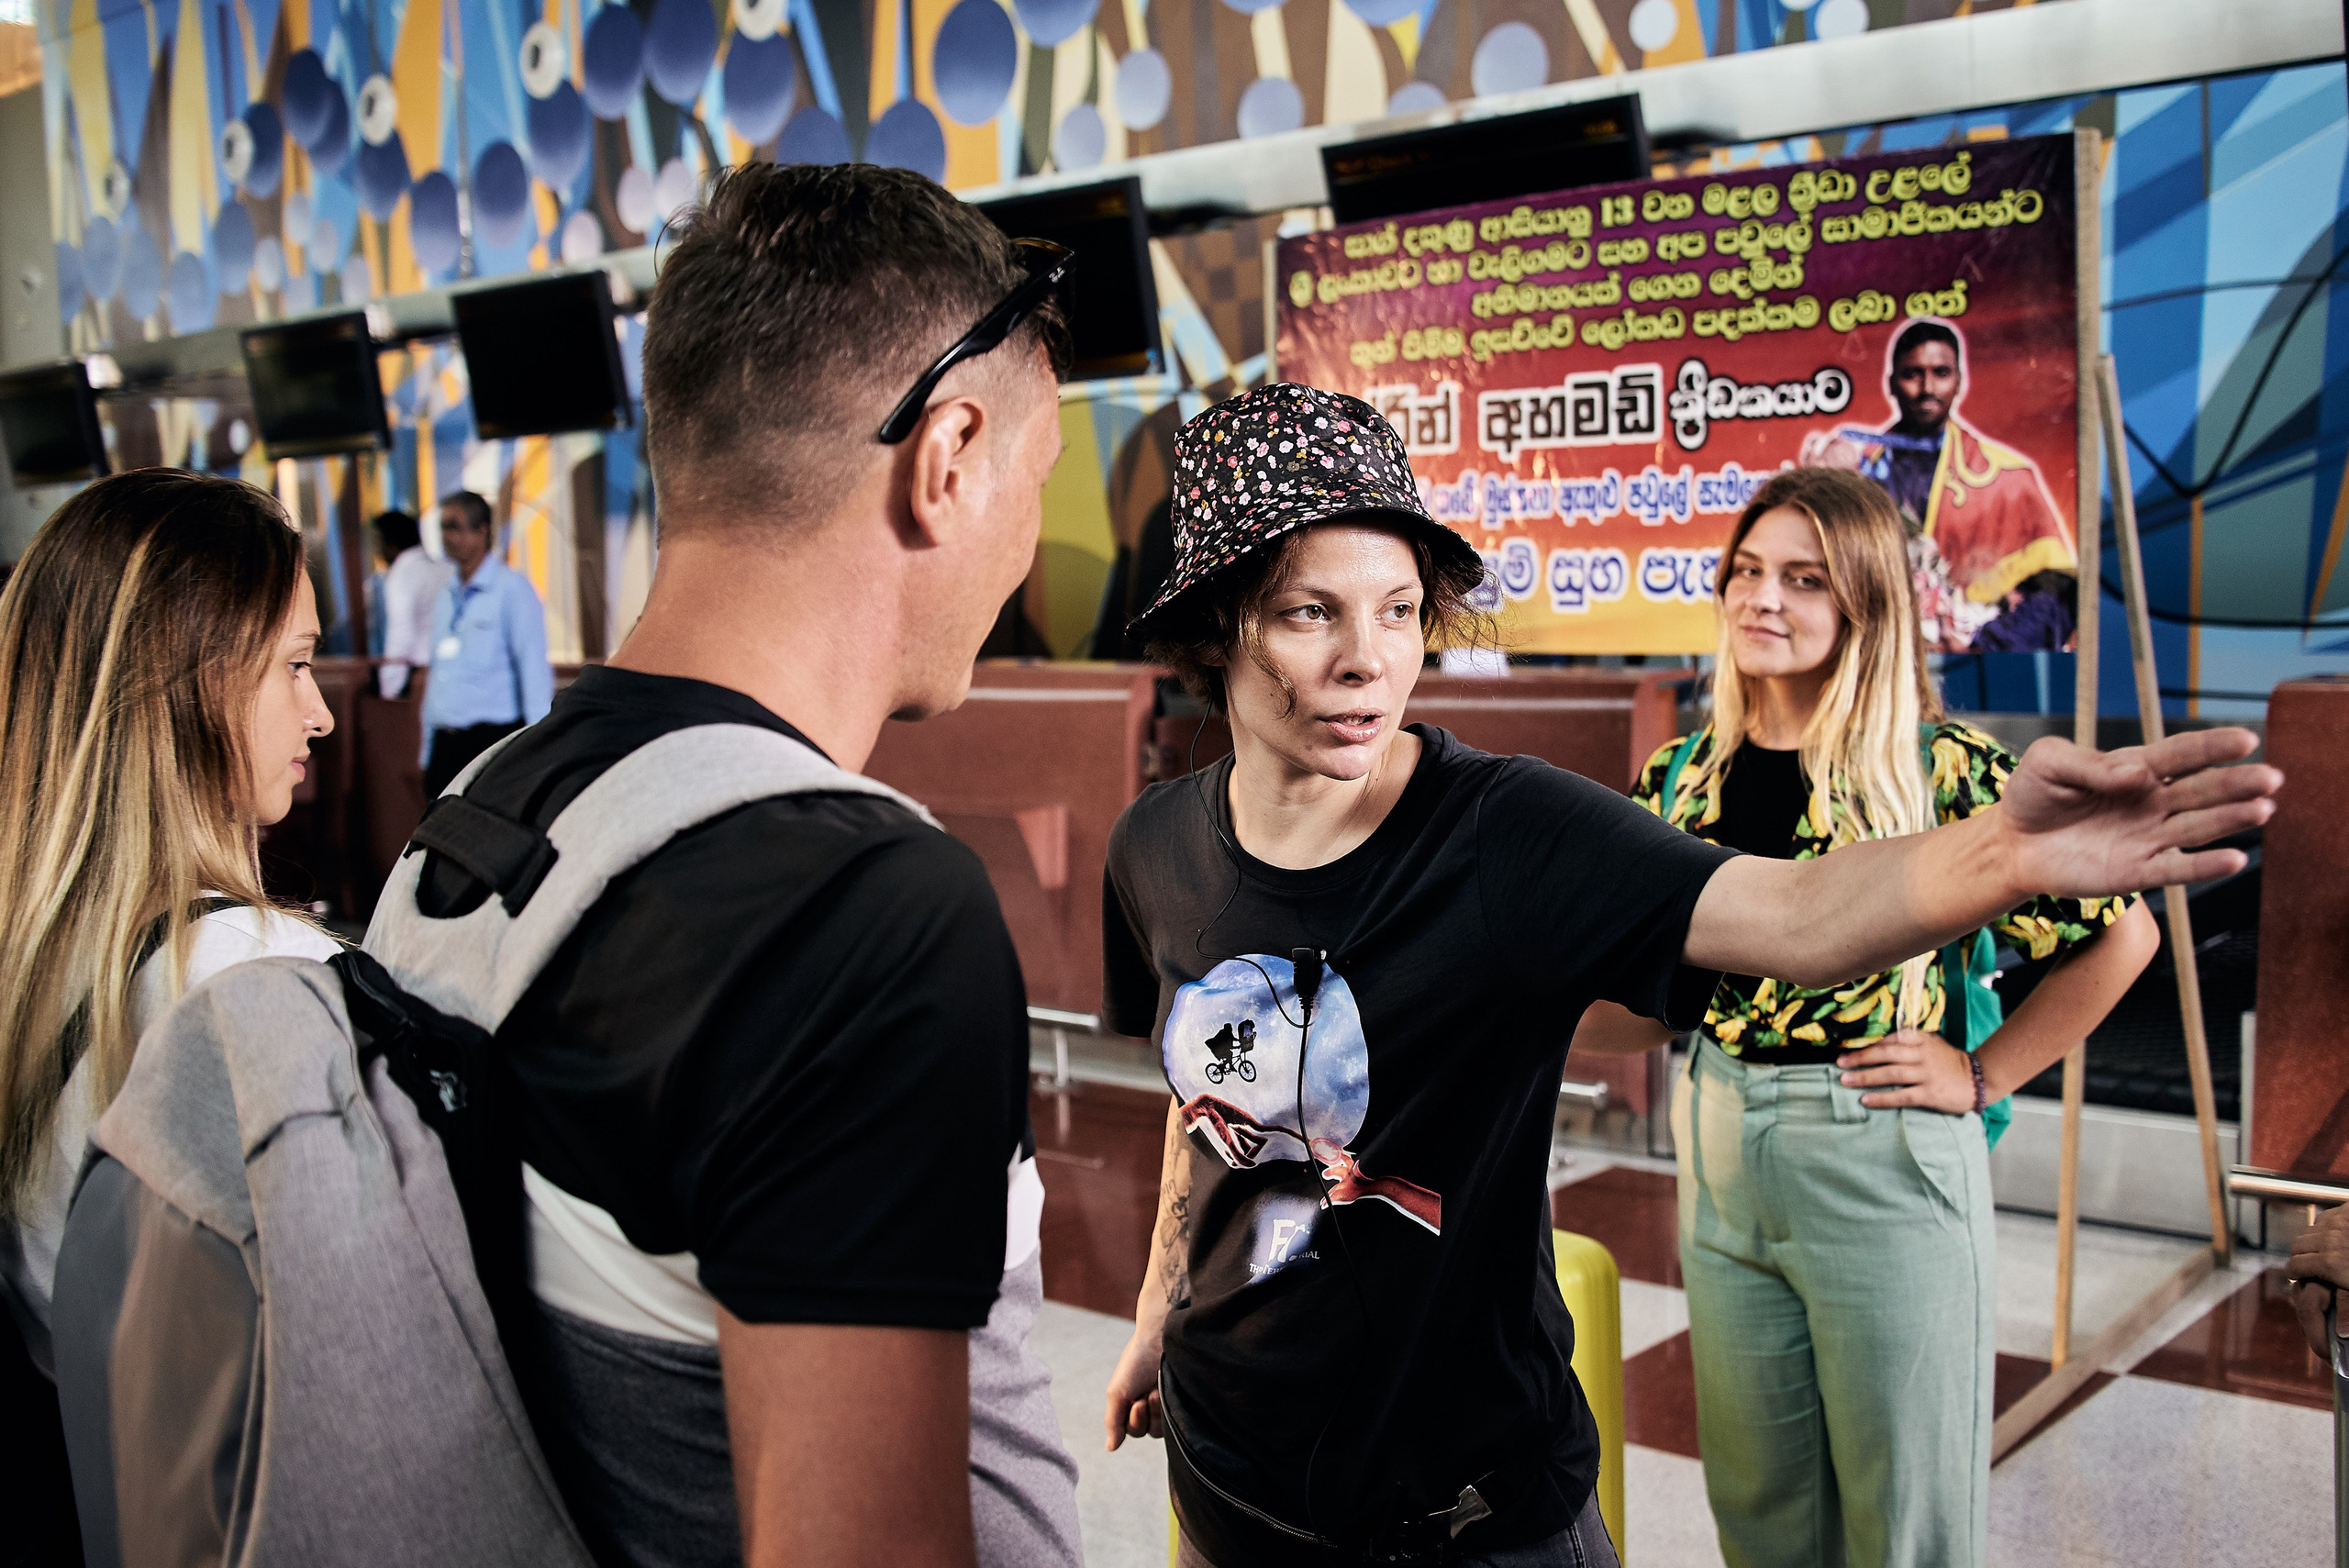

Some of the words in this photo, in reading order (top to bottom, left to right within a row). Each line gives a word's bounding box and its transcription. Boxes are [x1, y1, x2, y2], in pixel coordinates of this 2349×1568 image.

[1599, 194, 1636, 228] 13
[1641, 189, 1696, 222] වන
[1701, 182, 1781, 219] මළල
[1865, 150, 1973, 204] උළලේ
[1468, 239, 1592, 284] වැලිගමට
[1597, 237, 1650, 267] සහ
[1655, 229, 1708, 266] අප
[1714, 211, 1813, 261] පවුලේ
[1820, 188, 2044, 244] සාමාජිකයන්ට
[1627, 272, 1702, 303] ගෙන
[1709, 253, 1805, 300] දෙමින්
[1828, 288, 1897, 331] ලබා
[1905, 278, 1968, 318] ගත්
